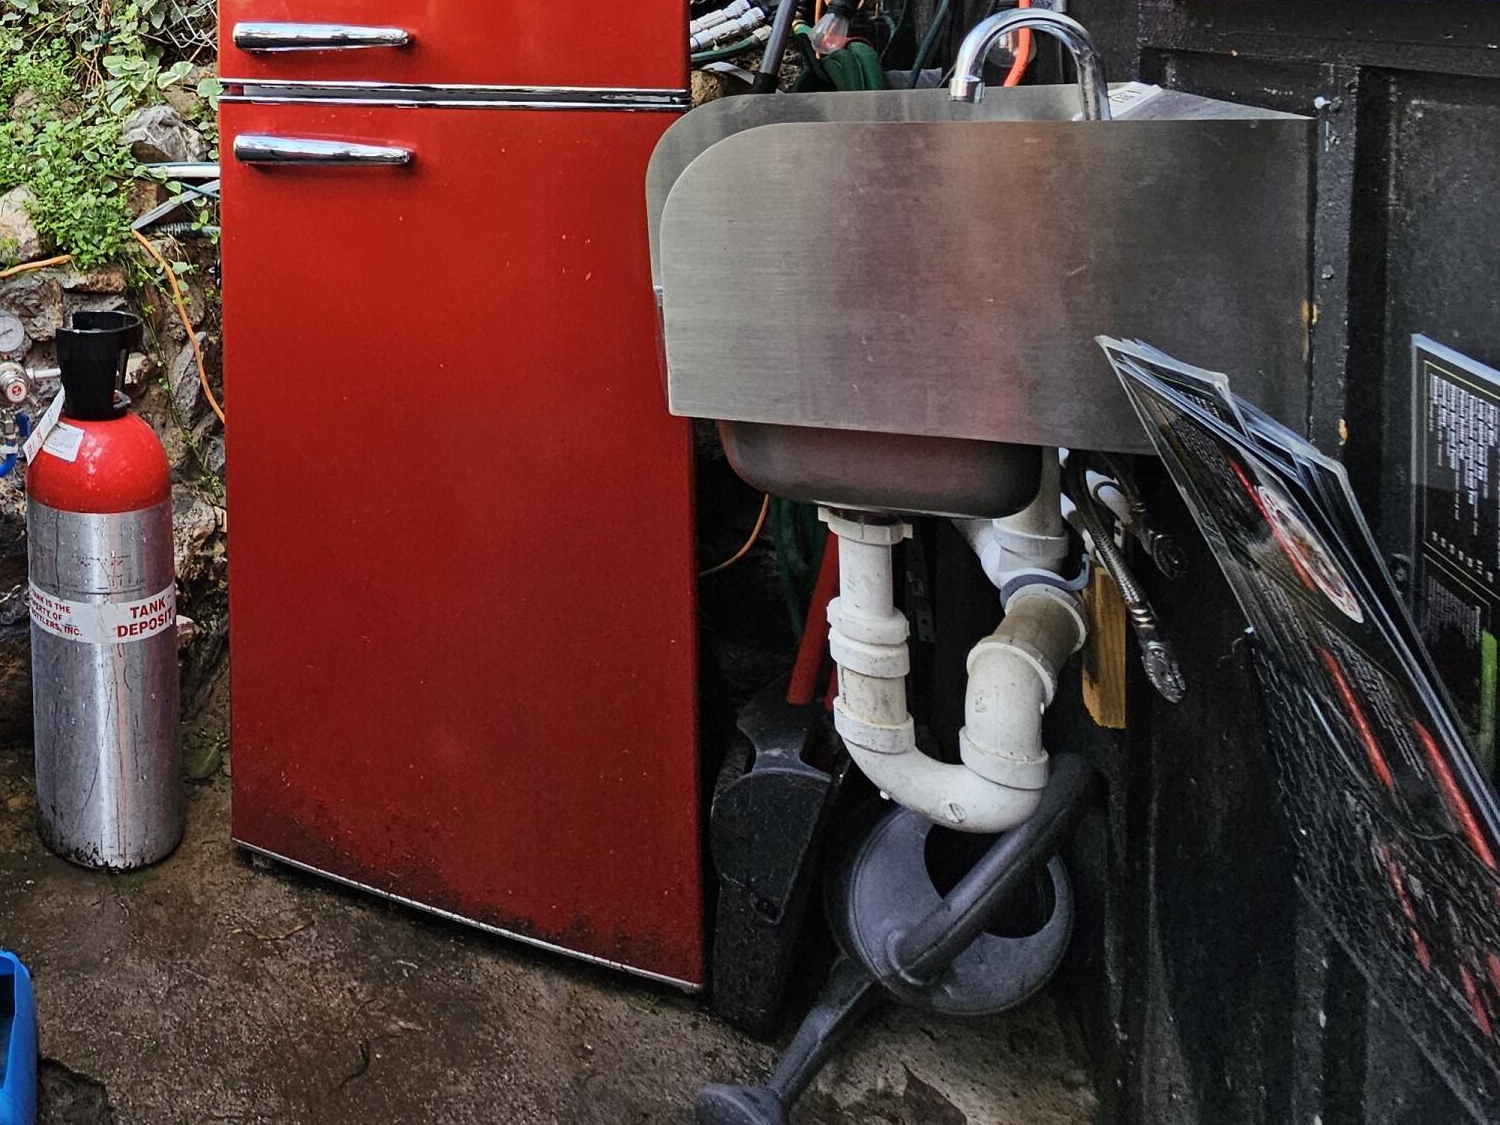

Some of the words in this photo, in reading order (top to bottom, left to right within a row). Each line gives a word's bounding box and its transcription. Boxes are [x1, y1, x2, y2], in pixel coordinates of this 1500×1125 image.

[45, 598, 53, 608] IS
[54, 602, 72, 614] THE
[129, 597, 166, 619] TANK
[52, 612, 63, 621] OF
[116, 606, 174, 638] DEPOSIT
[63, 625, 83, 637] INC.
